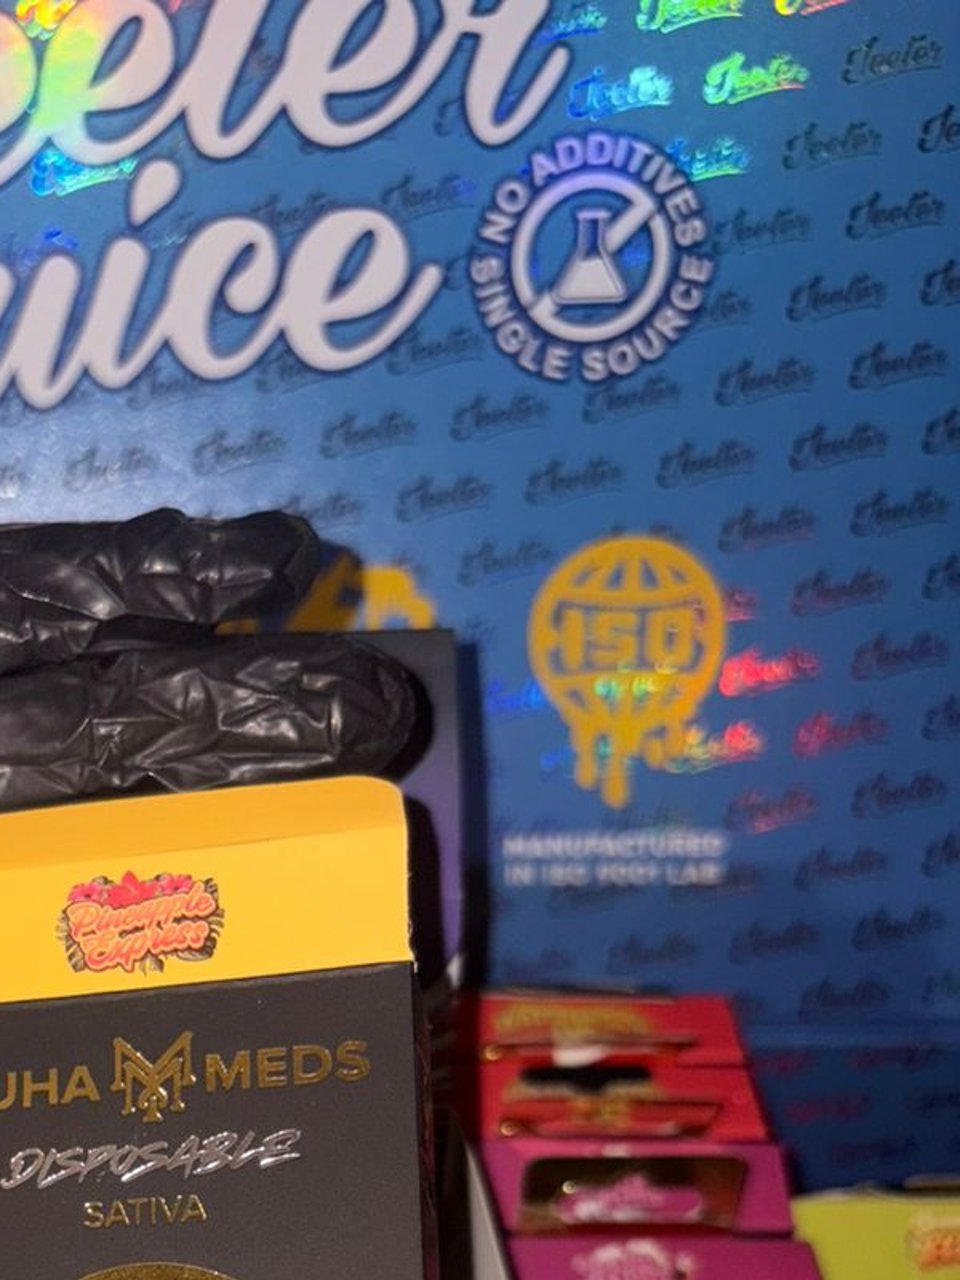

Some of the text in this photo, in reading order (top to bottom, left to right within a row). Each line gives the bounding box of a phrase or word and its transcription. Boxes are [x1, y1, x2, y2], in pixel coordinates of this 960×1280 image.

[843, 34, 942, 87] Jeeter
[782, 120, 883, 170] Jeeter
[480, 131, 704, 246] NO ADDITIVES
[470, 253, 715, 381] SINGLE SOURCE
[556, 606, 696, 672] ISO
[64, 881, 217, 941] Pineapple
[79, 919, 210, 973] Express
[205, 1040, 372, 1093] MEDS
[0, 1127, 302, 1190] DISPOSABLE
[83, 1193, 208, 1229] SATIVA
